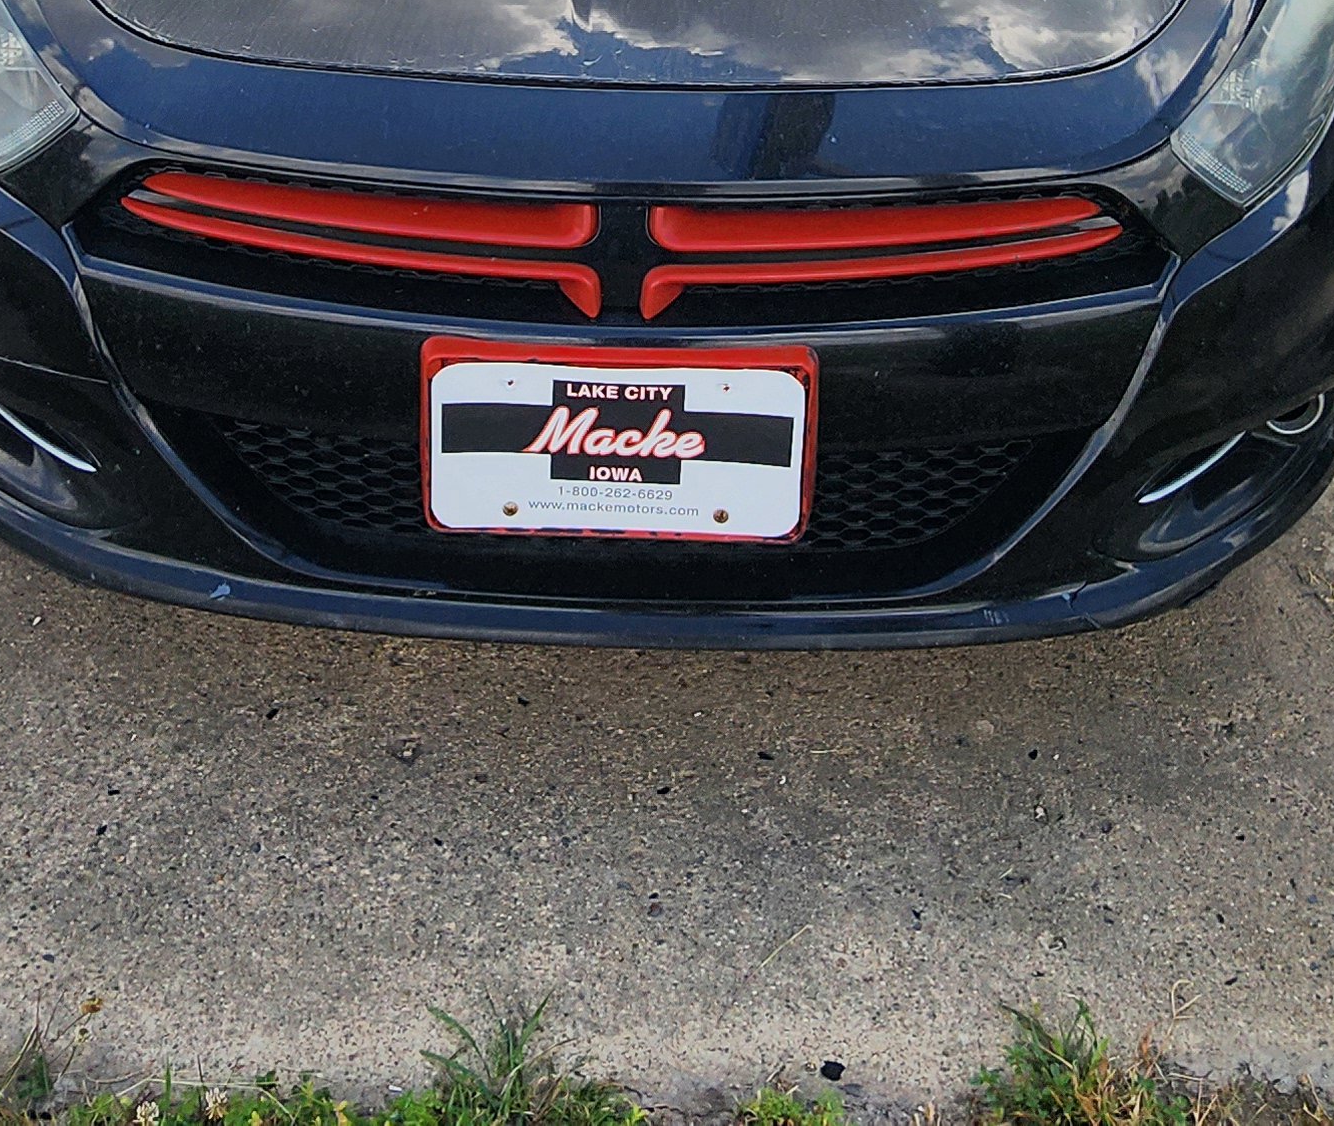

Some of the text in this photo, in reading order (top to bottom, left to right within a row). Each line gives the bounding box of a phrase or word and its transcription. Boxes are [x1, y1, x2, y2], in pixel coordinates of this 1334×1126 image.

[565, 382, 673, 402] LAKE CITY
[521, 404, 706, 460] Macke
[588, 465, 643, 482] IOWA
[557, 485, 674, 501] 1-800-262-6629
[527, 499, 700, 517] www.mackemotors.com
